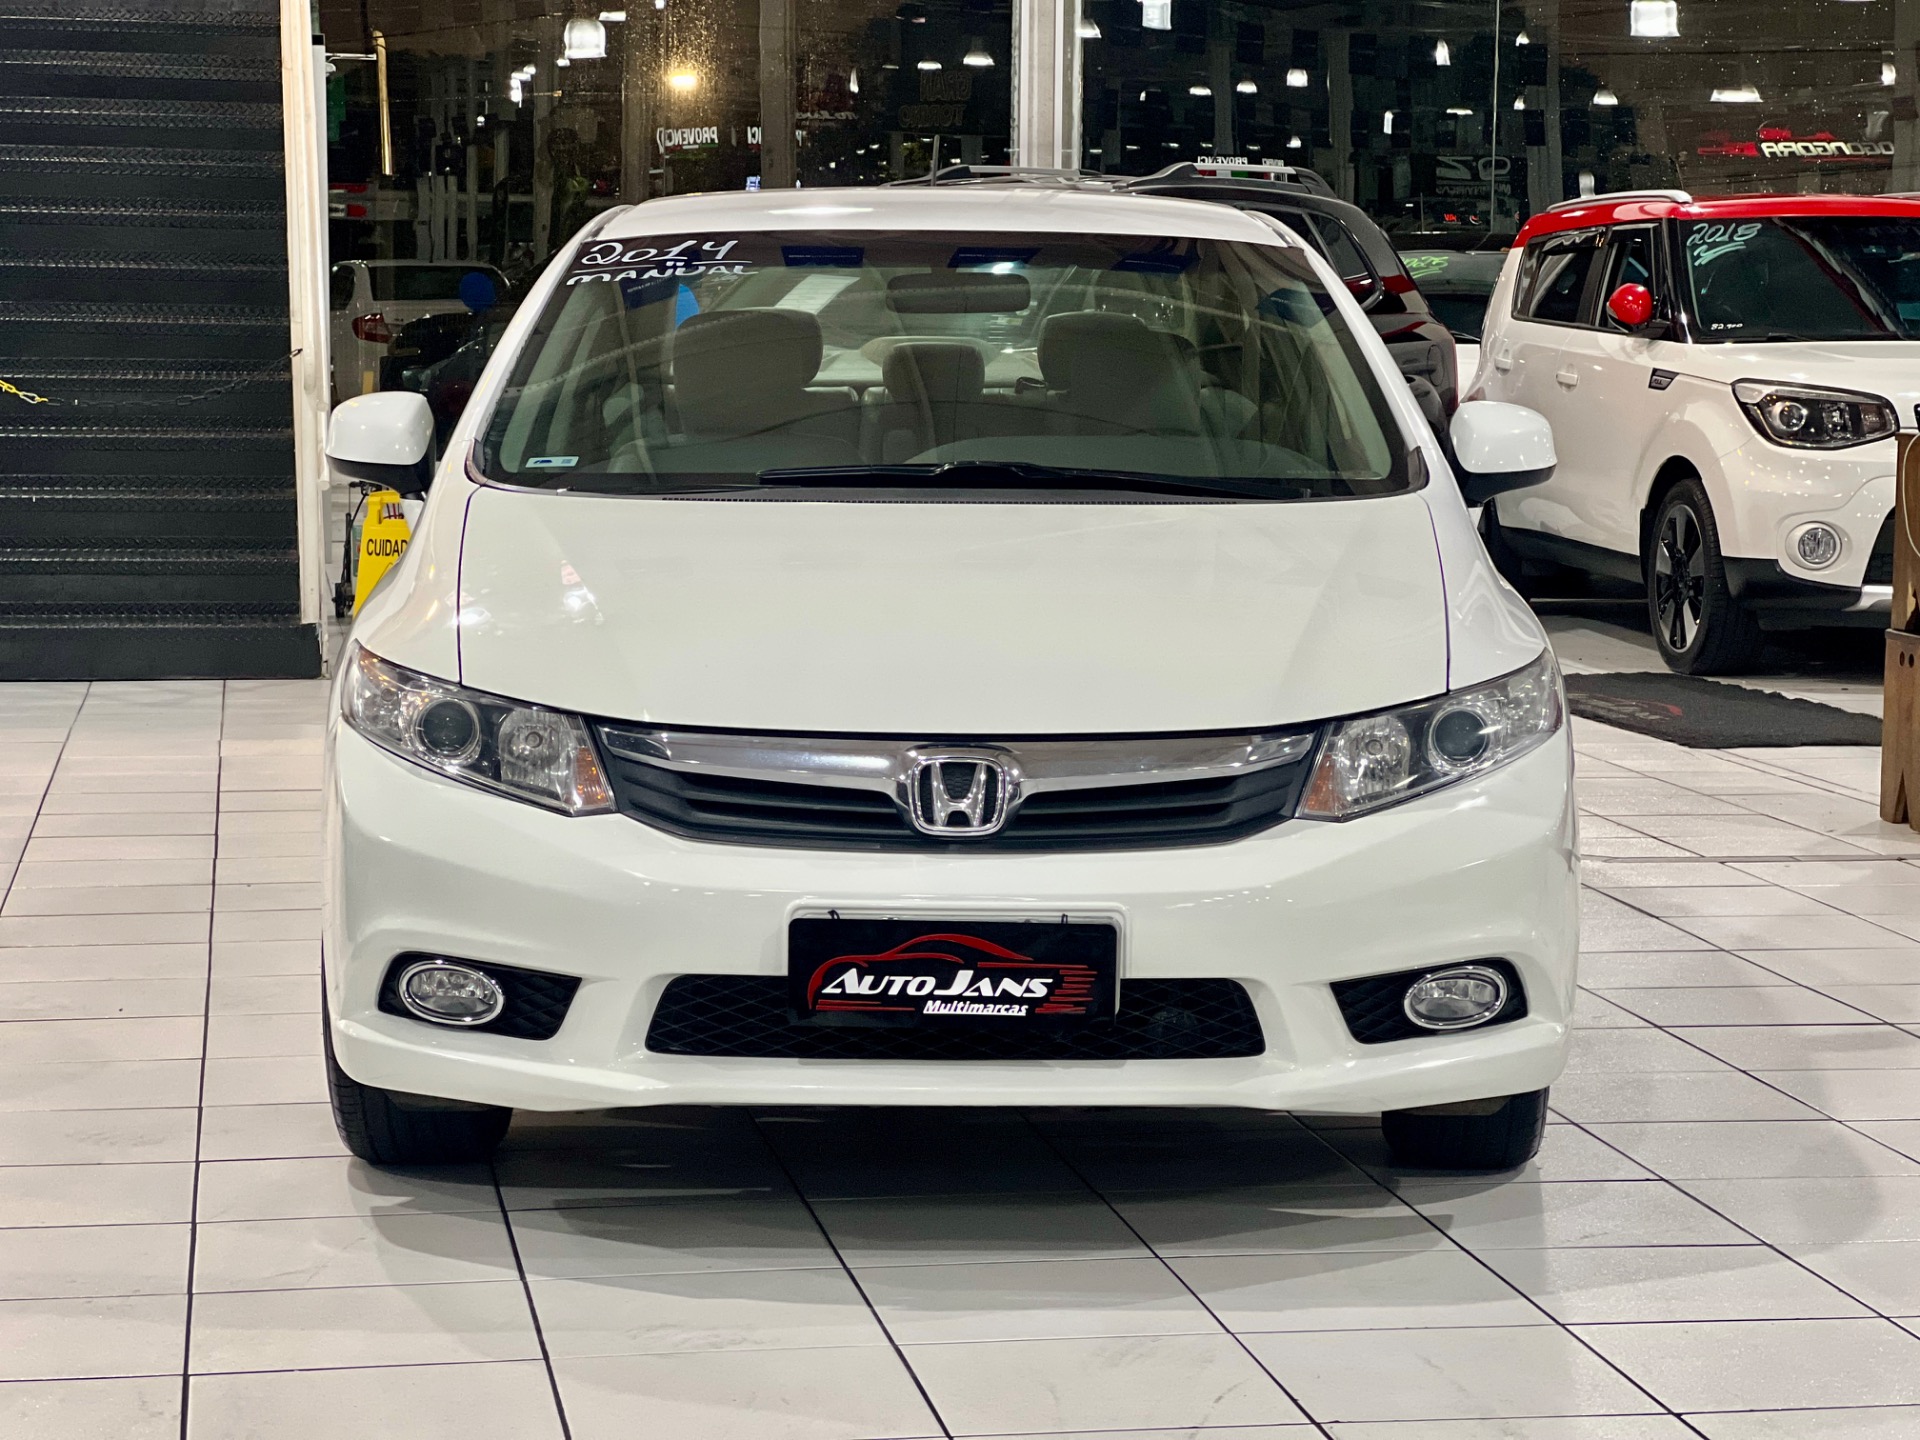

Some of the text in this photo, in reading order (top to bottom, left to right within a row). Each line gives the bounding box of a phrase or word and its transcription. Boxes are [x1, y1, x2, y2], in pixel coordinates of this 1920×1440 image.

[1686, 223, 1762, 247] 2018
[581, 240, 739, 265] 2014
[923, 1000, 1029, 1016] Multimarcas
